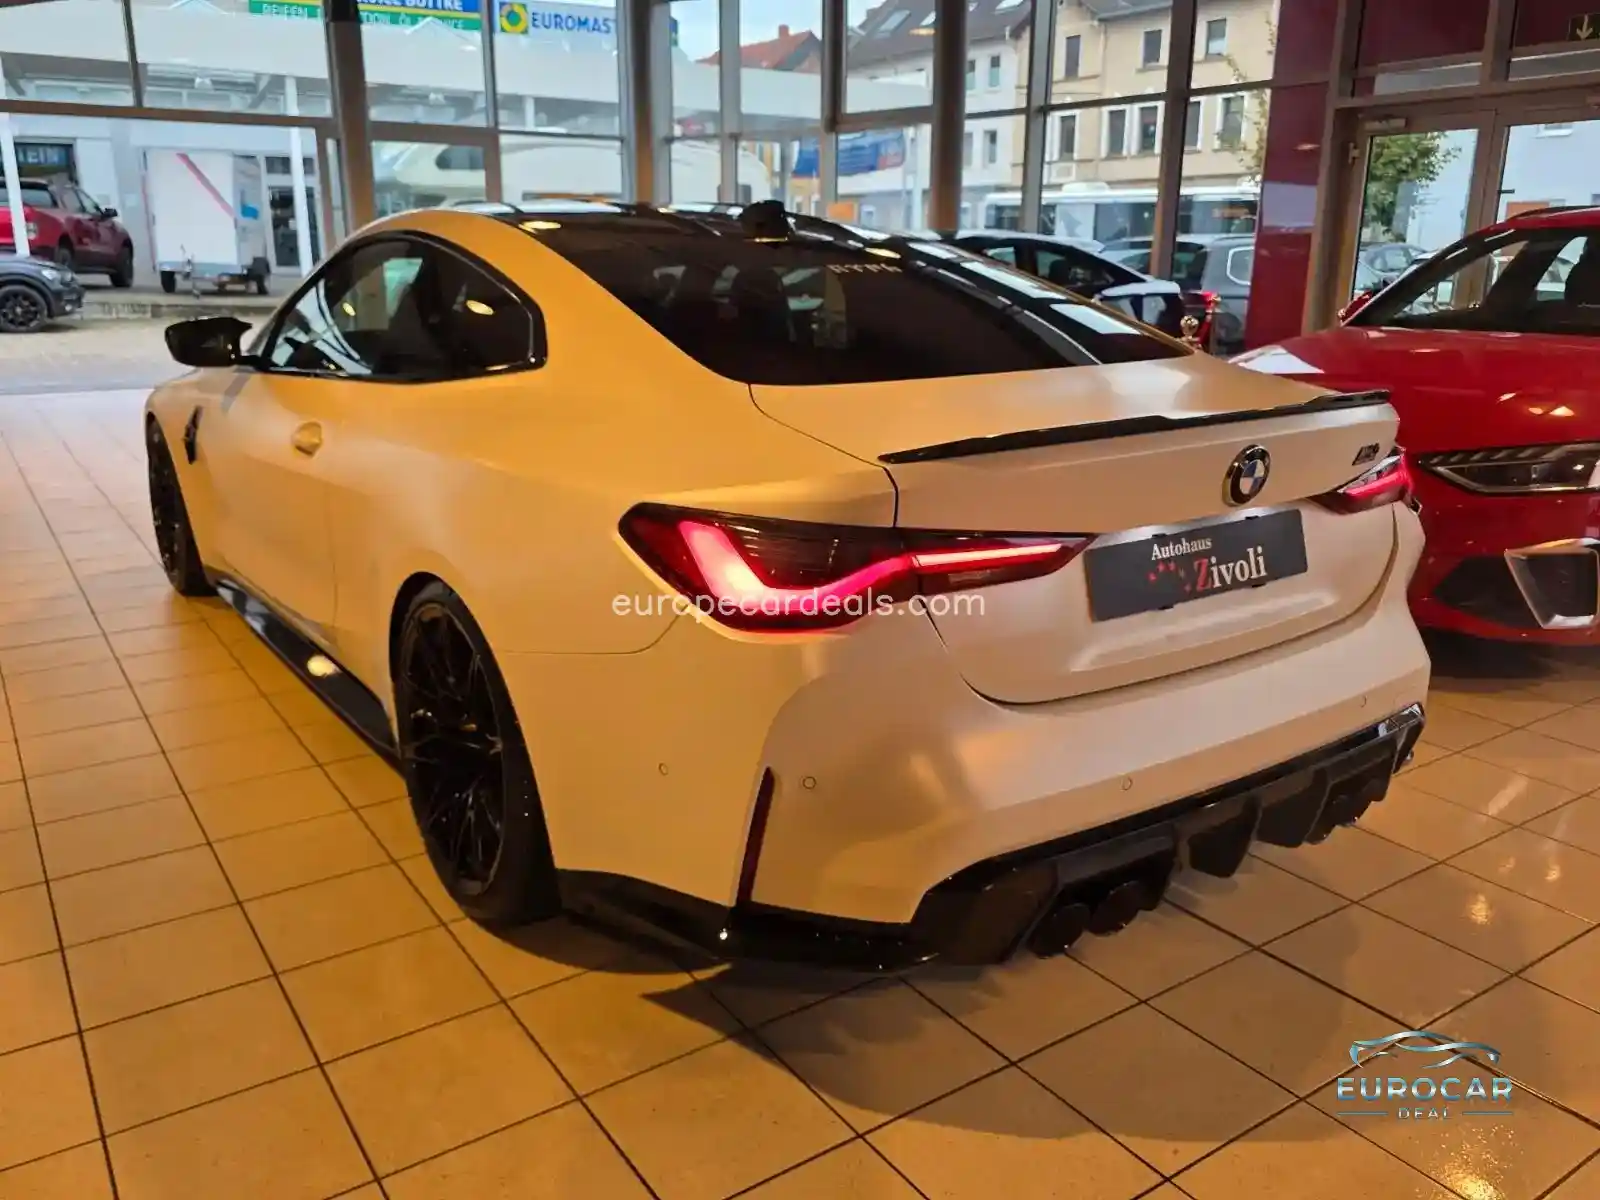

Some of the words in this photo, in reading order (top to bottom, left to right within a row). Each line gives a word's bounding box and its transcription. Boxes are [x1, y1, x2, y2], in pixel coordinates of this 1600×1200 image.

[531, 11, 616, 34] EUROMAS
[1151, 537, 1212, 561] Autohaus
[1194, 545, 1268, 593] Zivoli
